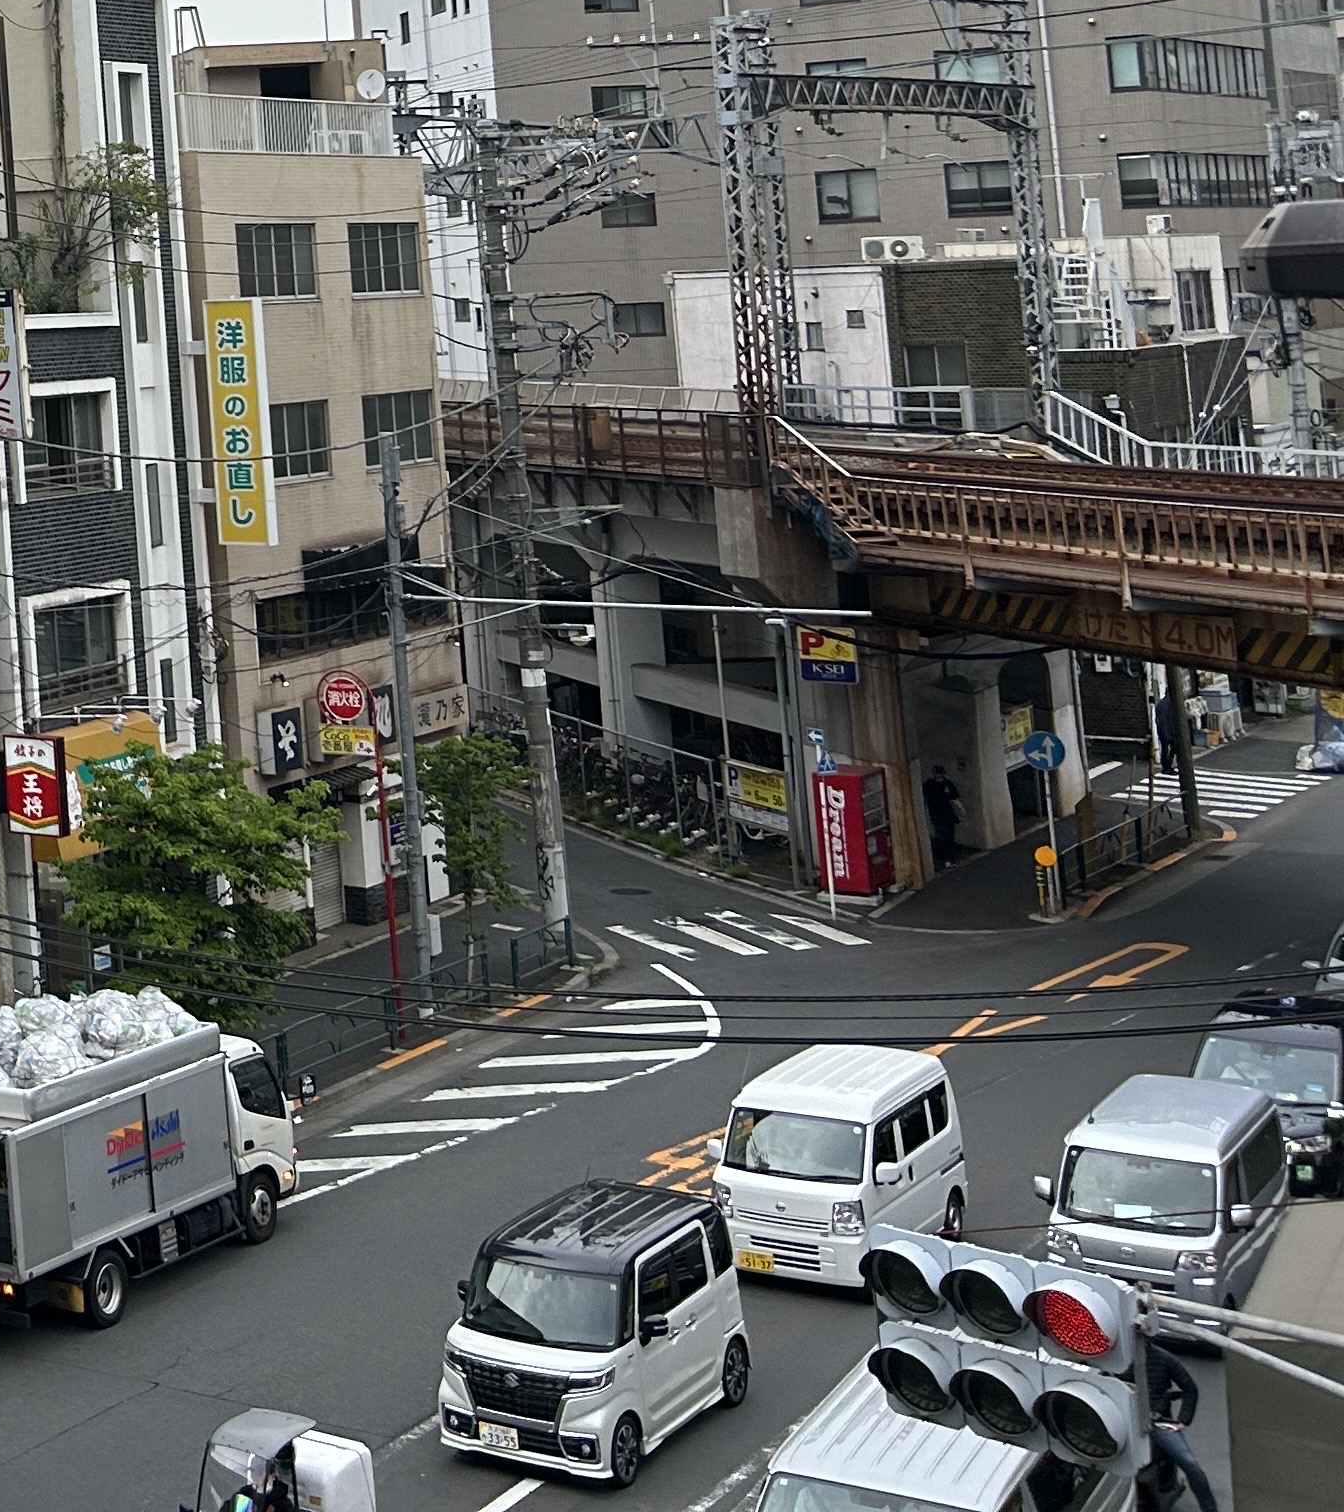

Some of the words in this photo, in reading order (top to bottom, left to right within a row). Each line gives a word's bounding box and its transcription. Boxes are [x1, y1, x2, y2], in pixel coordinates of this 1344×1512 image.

[217, 320, 255, 525] 洋服のお直し
[800, 631, 825, 656] P
[327, 689, 361, 708] 消火栓
[21, 773, 44, 818] 王将
